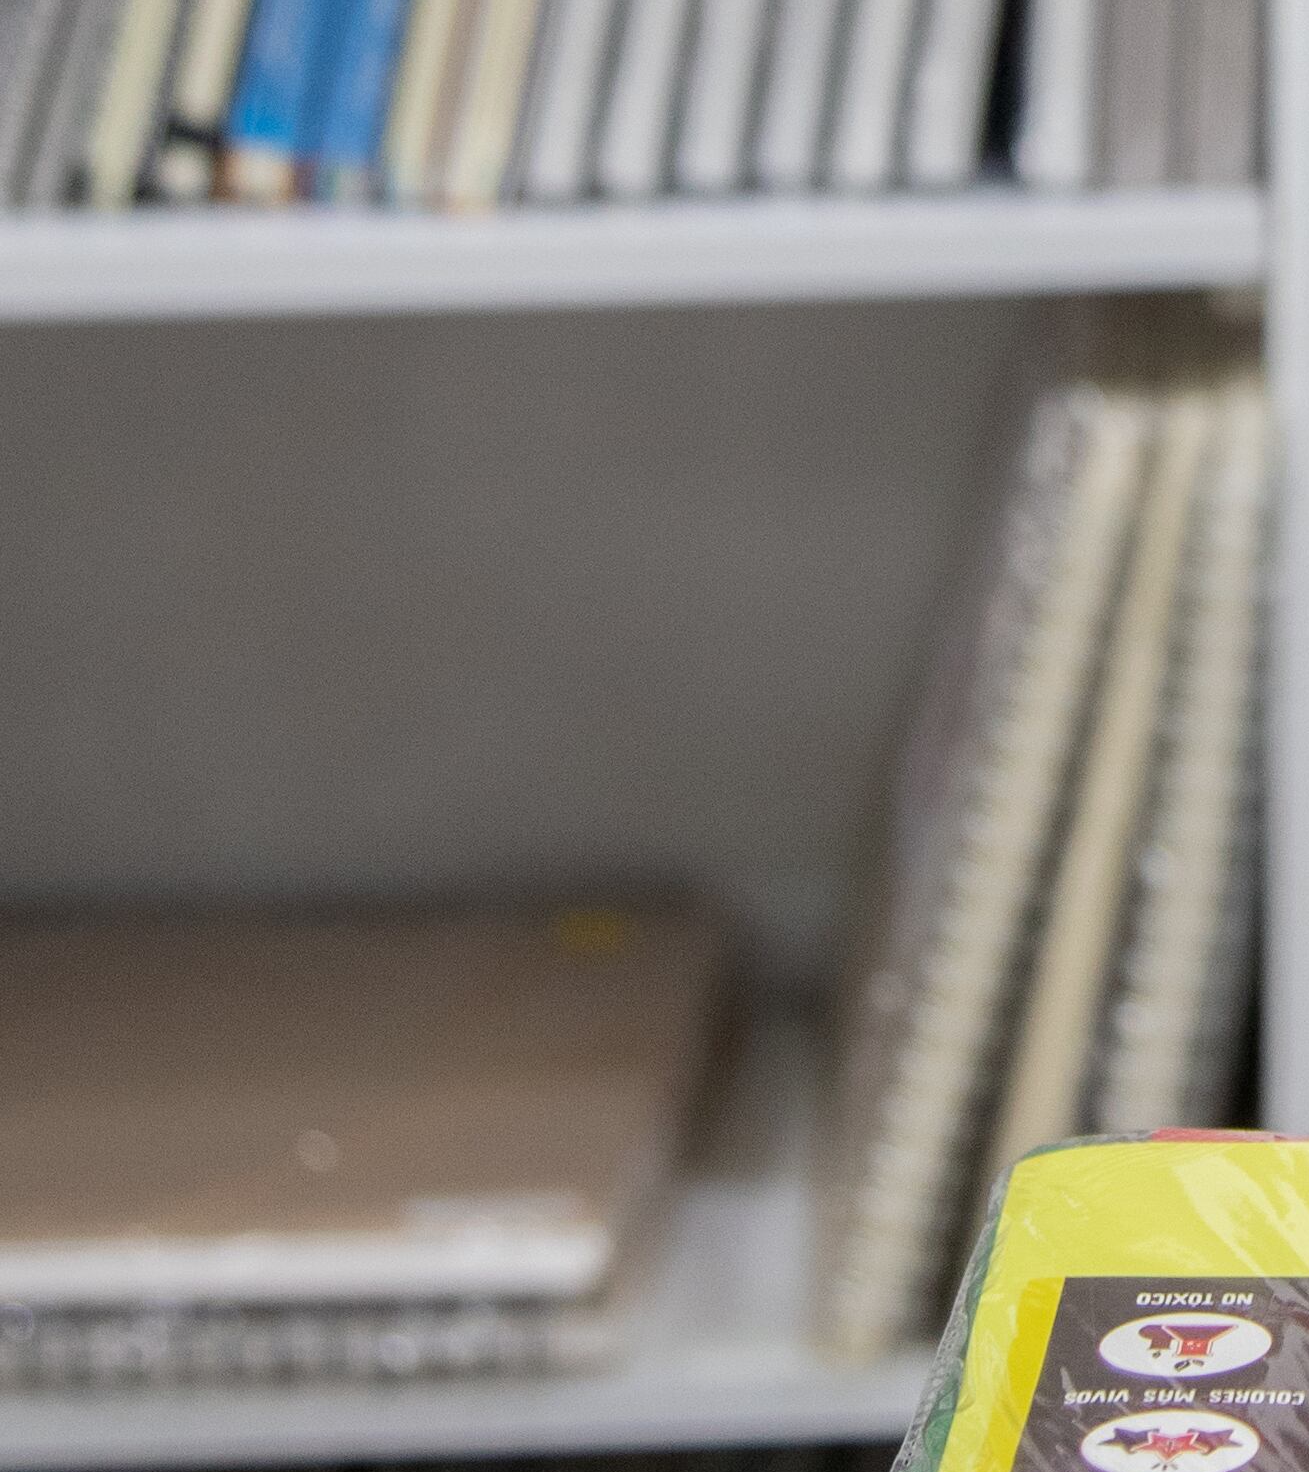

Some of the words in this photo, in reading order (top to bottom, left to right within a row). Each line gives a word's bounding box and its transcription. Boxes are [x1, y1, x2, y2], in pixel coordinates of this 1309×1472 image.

[1221, 1292, 1254, 1307] NO
[1062, 1388, 1130, 1406] VIVOS
[1208, 1388, 1306, 1406] COLORES
